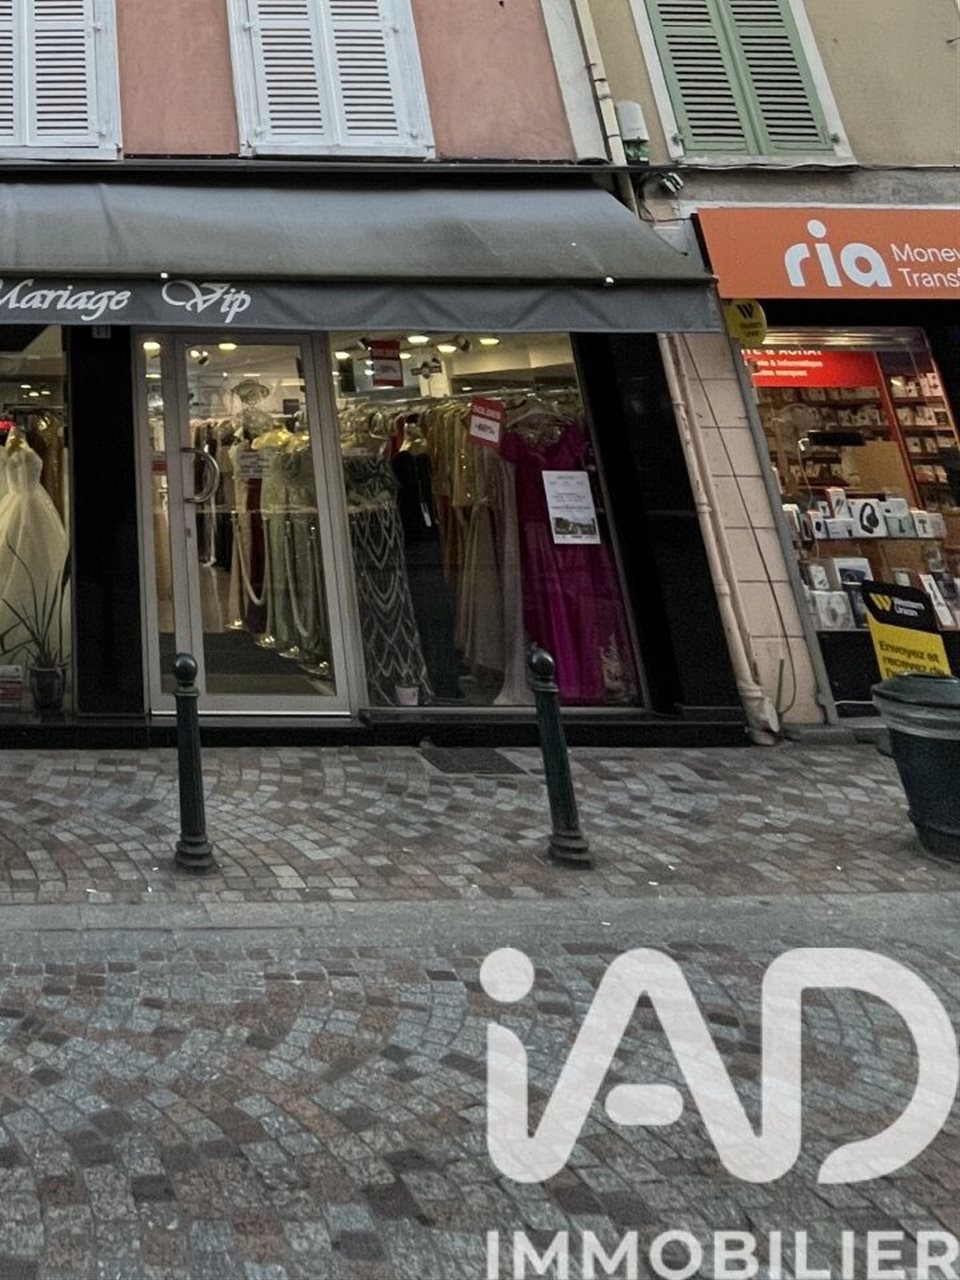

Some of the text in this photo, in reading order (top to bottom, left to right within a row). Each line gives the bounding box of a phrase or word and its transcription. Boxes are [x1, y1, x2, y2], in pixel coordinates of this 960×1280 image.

[784, 219, 892, 288] ria
[897, 267, 960, 288] Trans
[161, 279, 251, 323] Vip
[879, 640, 925, 659] Envoyez
